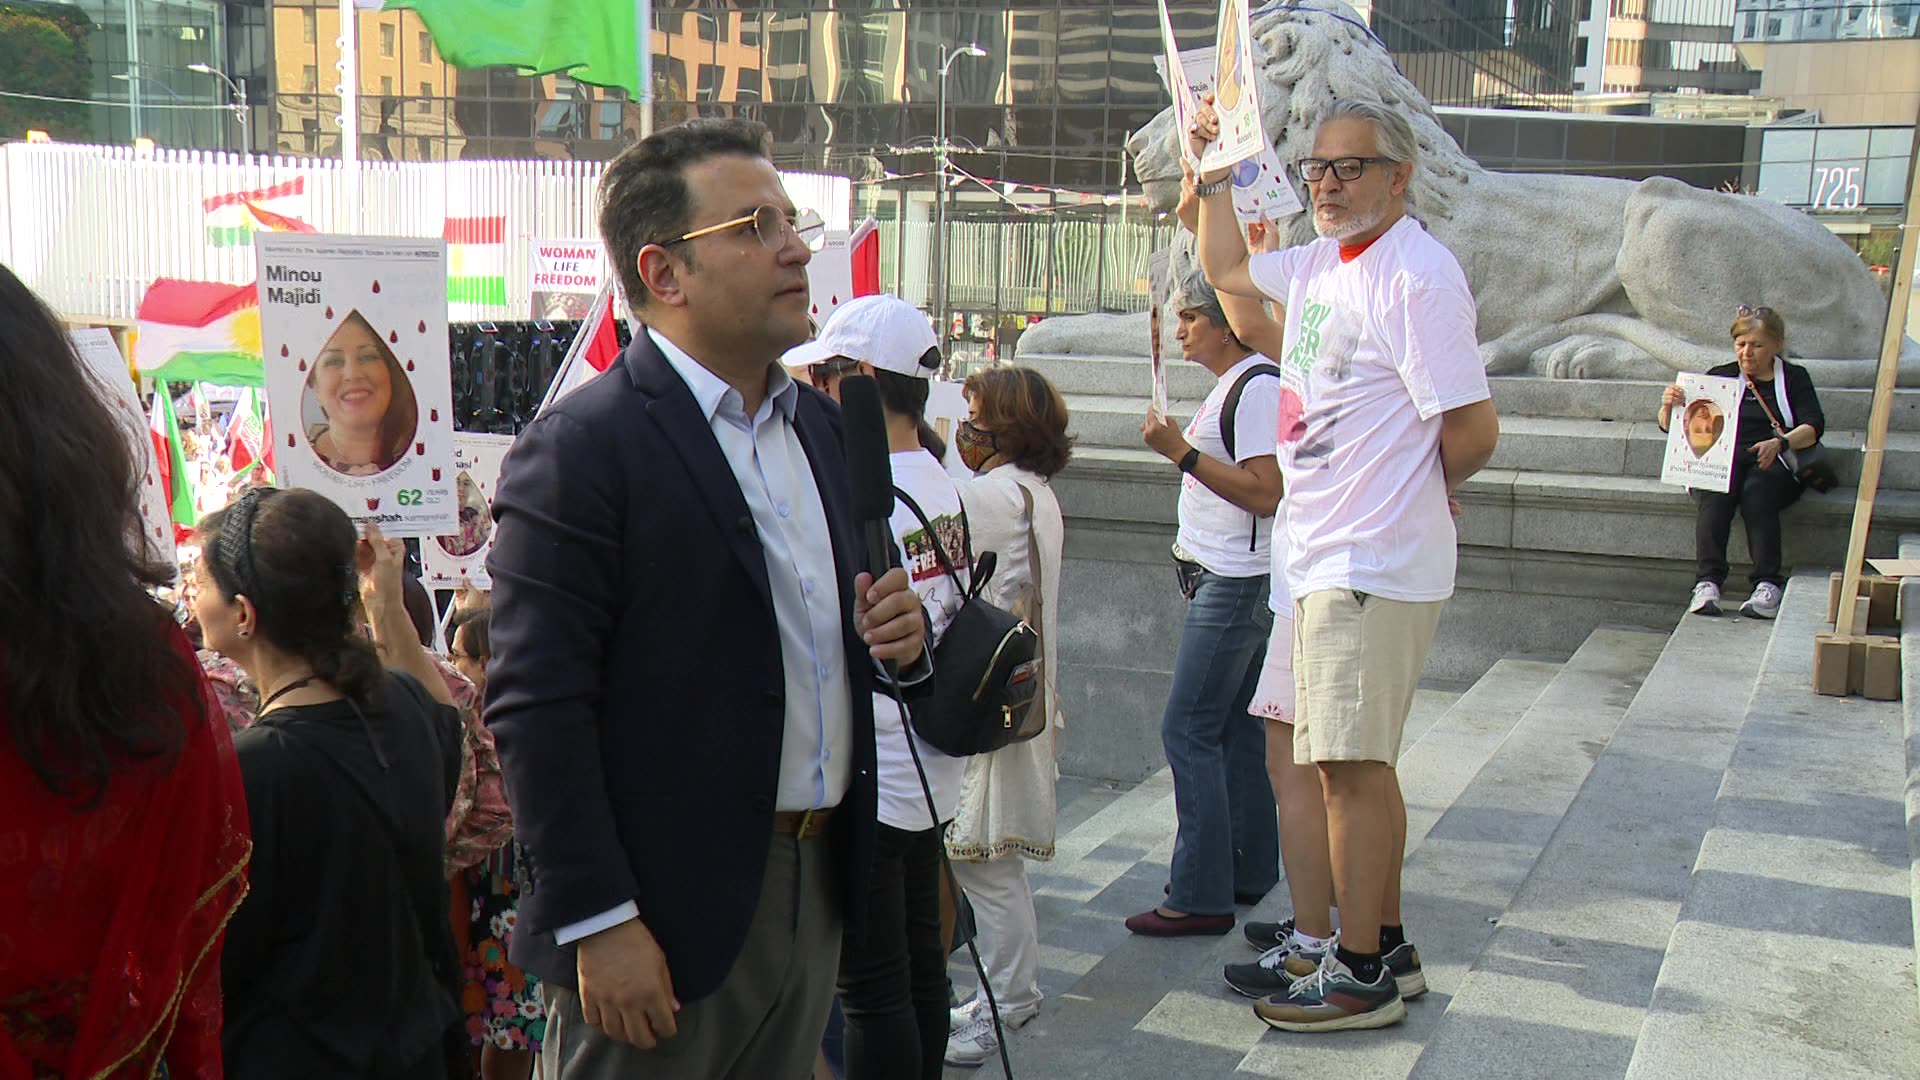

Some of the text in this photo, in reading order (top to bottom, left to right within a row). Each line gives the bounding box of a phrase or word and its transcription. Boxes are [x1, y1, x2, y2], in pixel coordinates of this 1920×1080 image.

[1266, 189, 1278, 200] 14
[1814, 167, 1860, 208] 725
[540, 247, 596, 259] WOMAN
[266, 265, 322, 282] Minou
[554, 261, 579, 272] LIFE
[534, 273, 597, 287] FREEDOM
[267, 287, 321, 307] Majidi
[397, 489, 423, 506] 62
[911, 549, 937, 574] FREE
